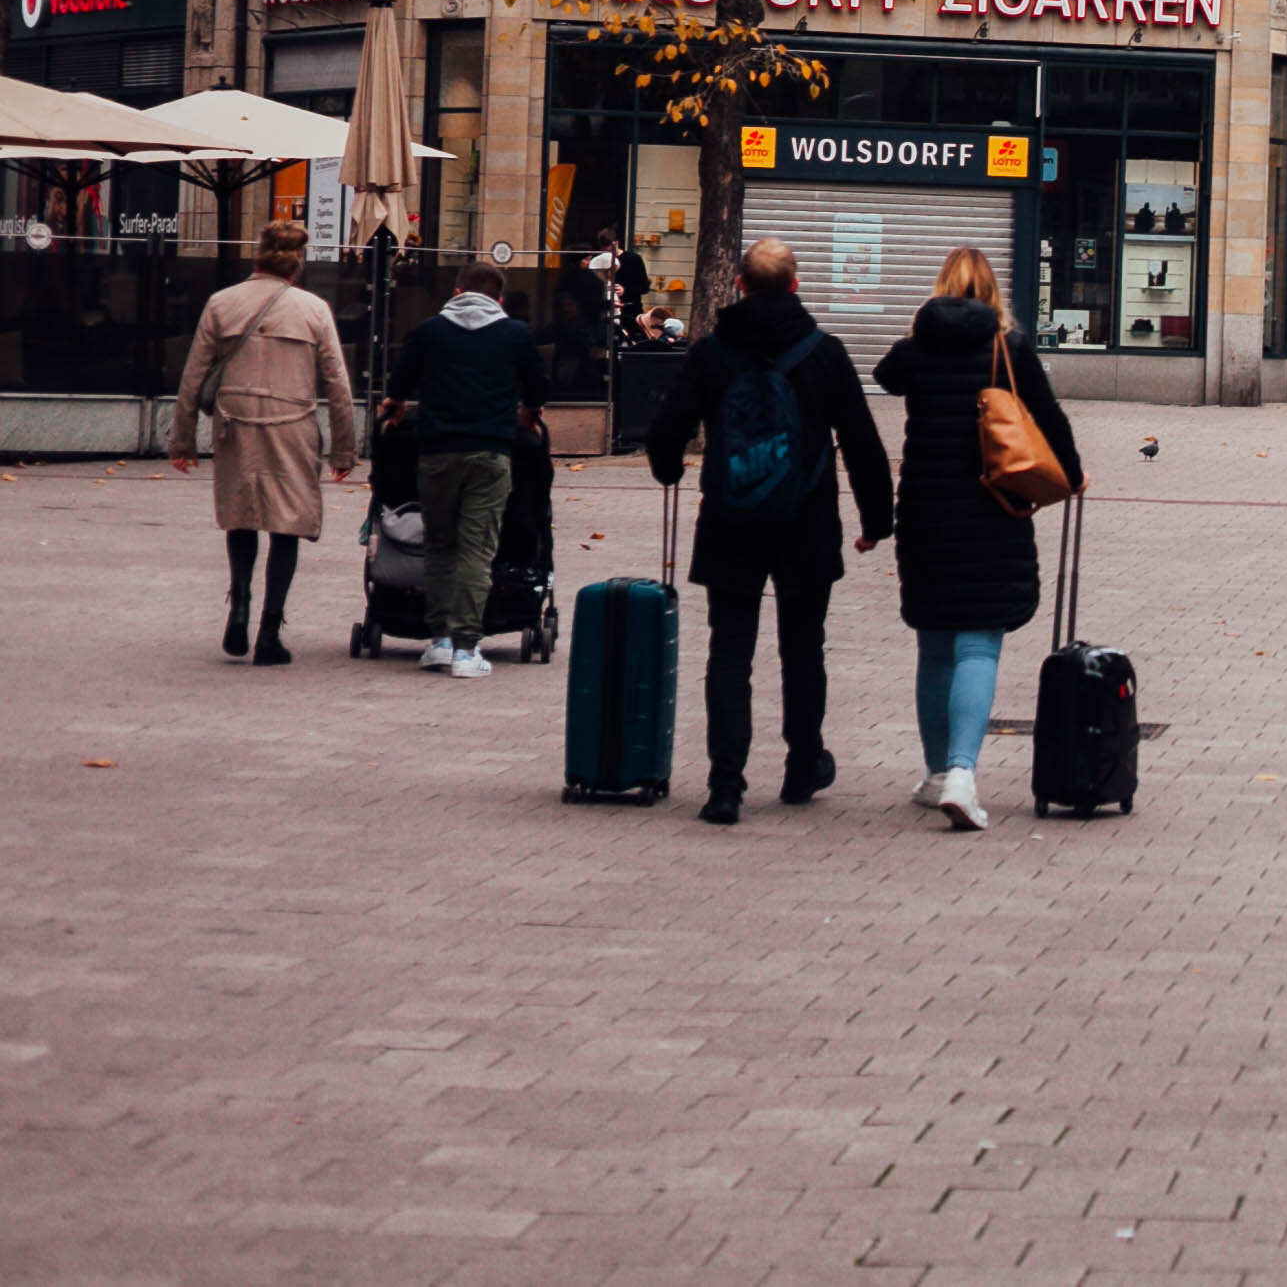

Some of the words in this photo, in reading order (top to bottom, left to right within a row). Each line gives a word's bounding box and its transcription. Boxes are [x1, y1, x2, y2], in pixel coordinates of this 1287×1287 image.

[741, 148, 769, 157] OTTO
[791, 137, 975, 167] WOLSDORFF
[993, 158, 1022, 167] LOTTO
